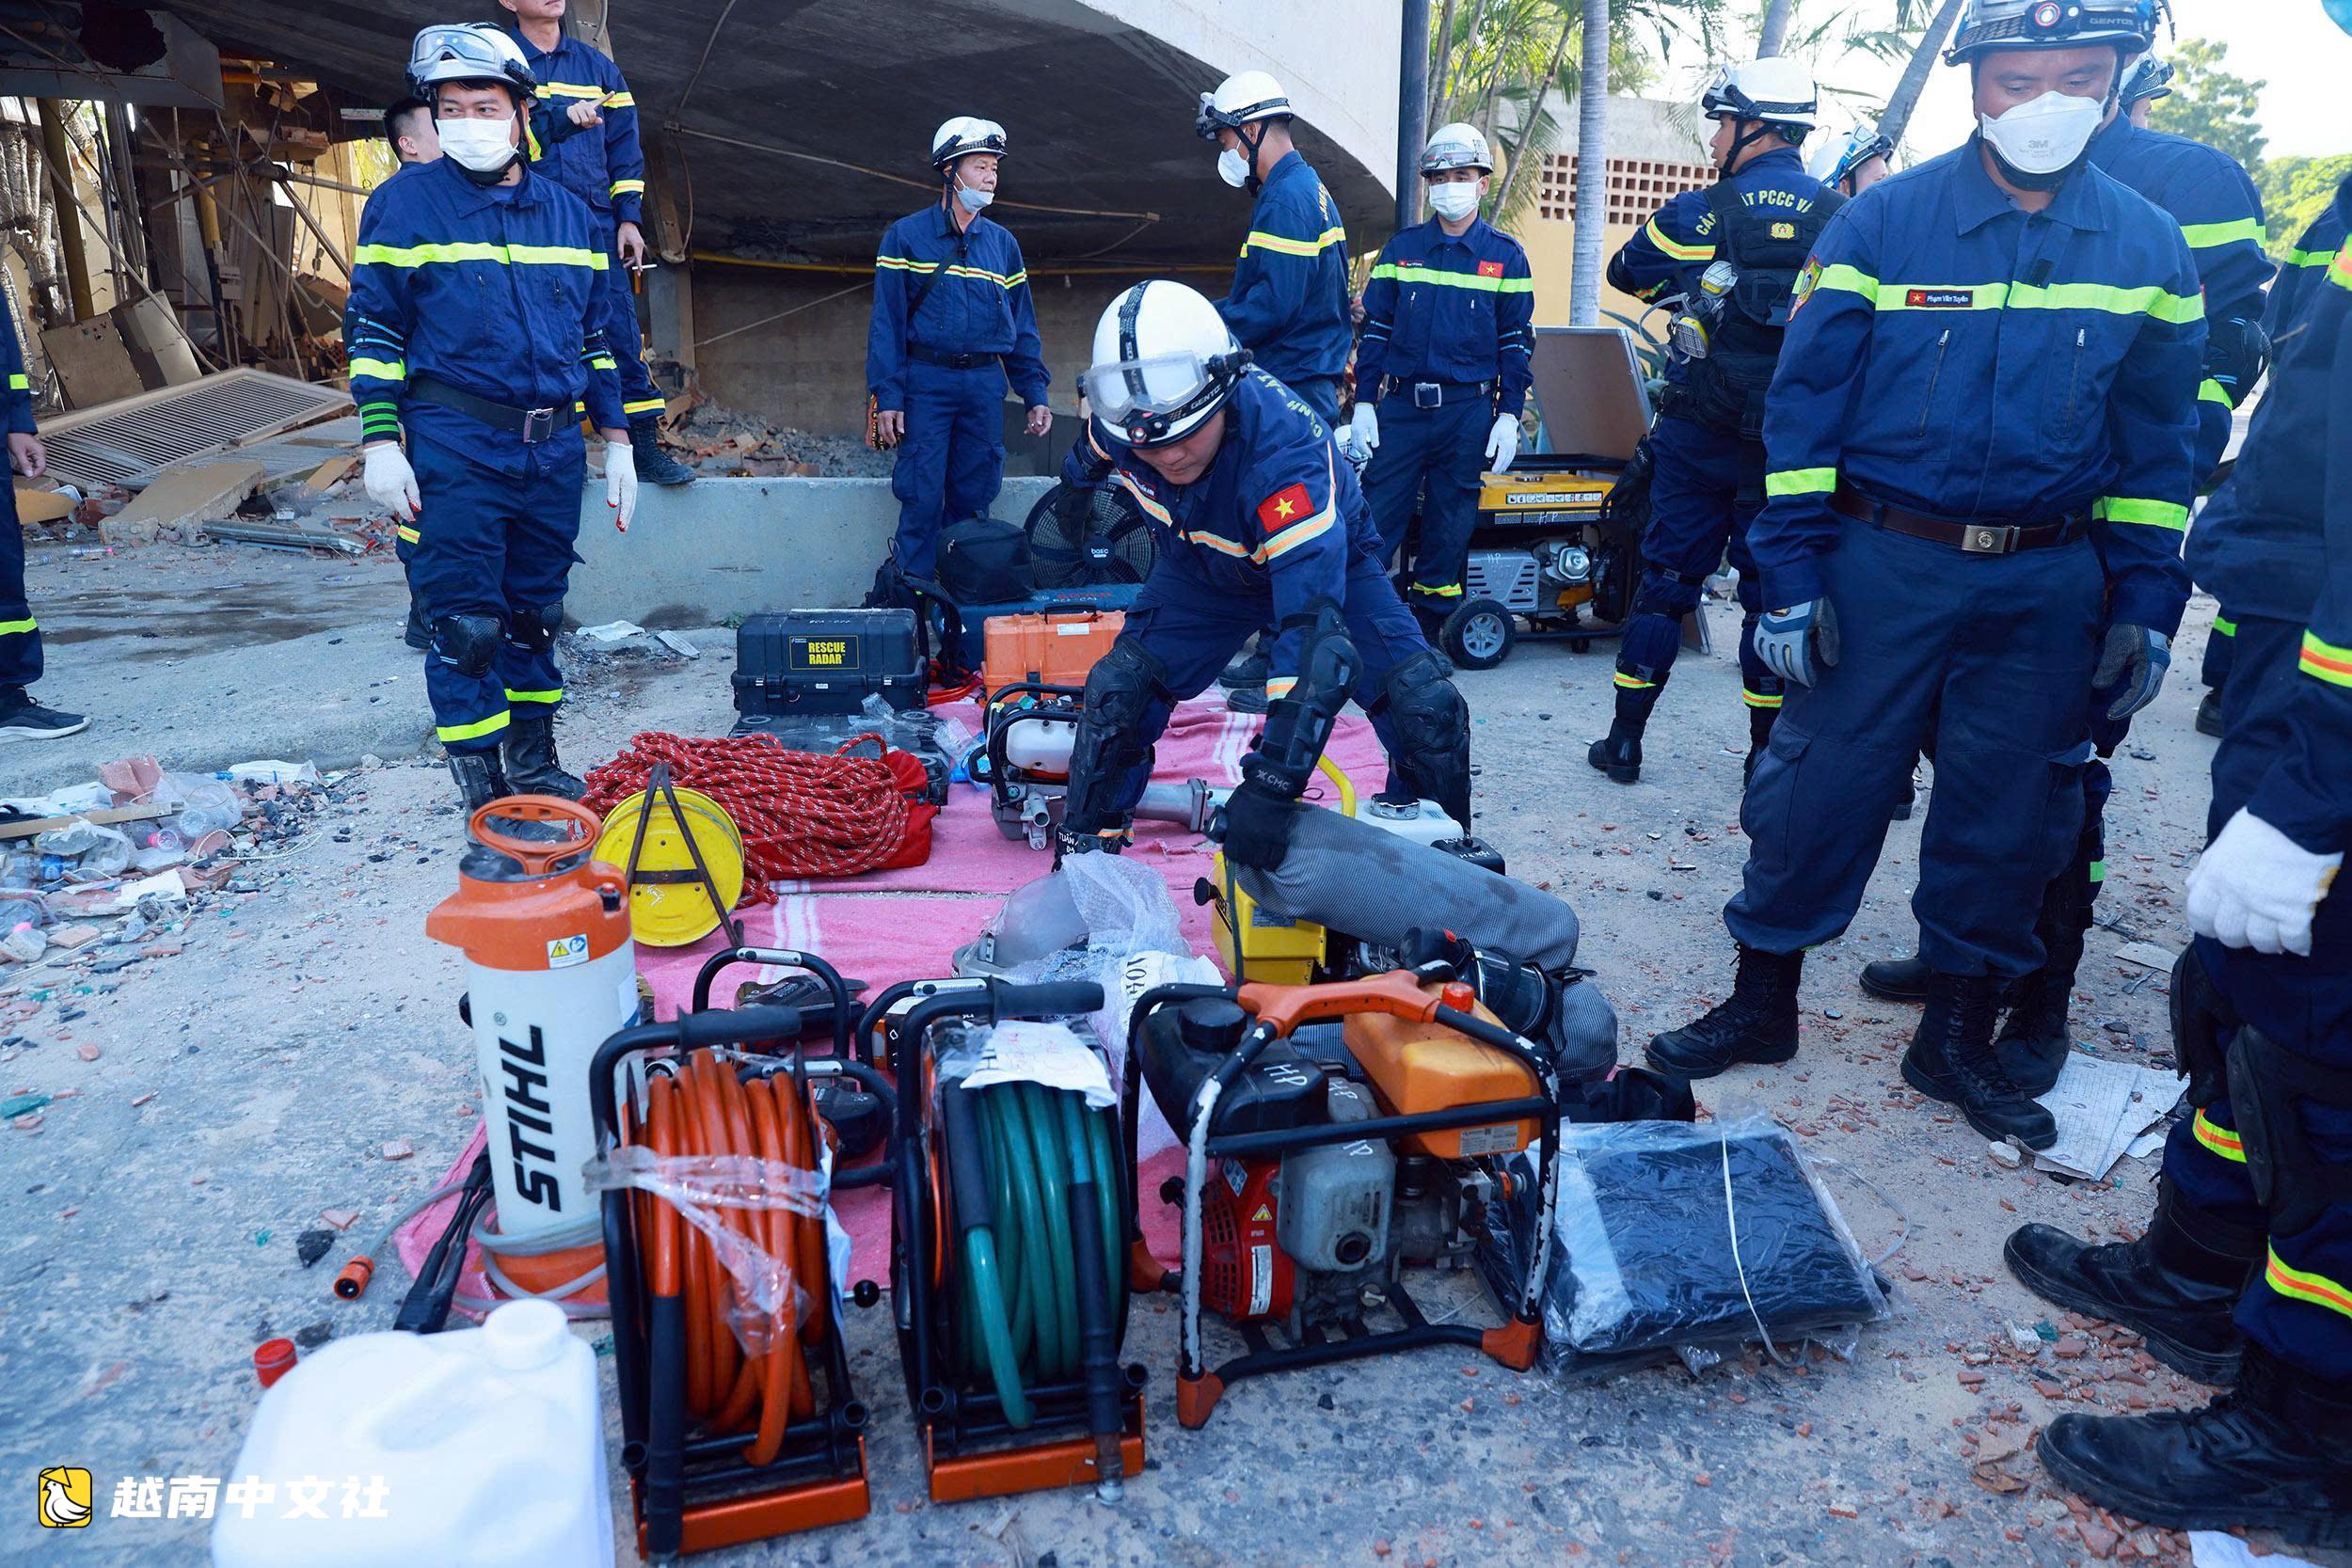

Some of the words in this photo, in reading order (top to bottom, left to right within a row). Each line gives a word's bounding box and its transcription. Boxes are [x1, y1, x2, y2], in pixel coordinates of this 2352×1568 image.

[2089, 17, 2134, 25] GENTOS
[2027, 139, 2049, 150] 3M
[1758, 189, 1795, 208] PCCC
[808, 641, 846, 653] RESCUE
[809, 654, 843, 665] RADAR
[1263, 1063, 1308, 1086] HP
[499, 1023, 563, 1213] STIHL
